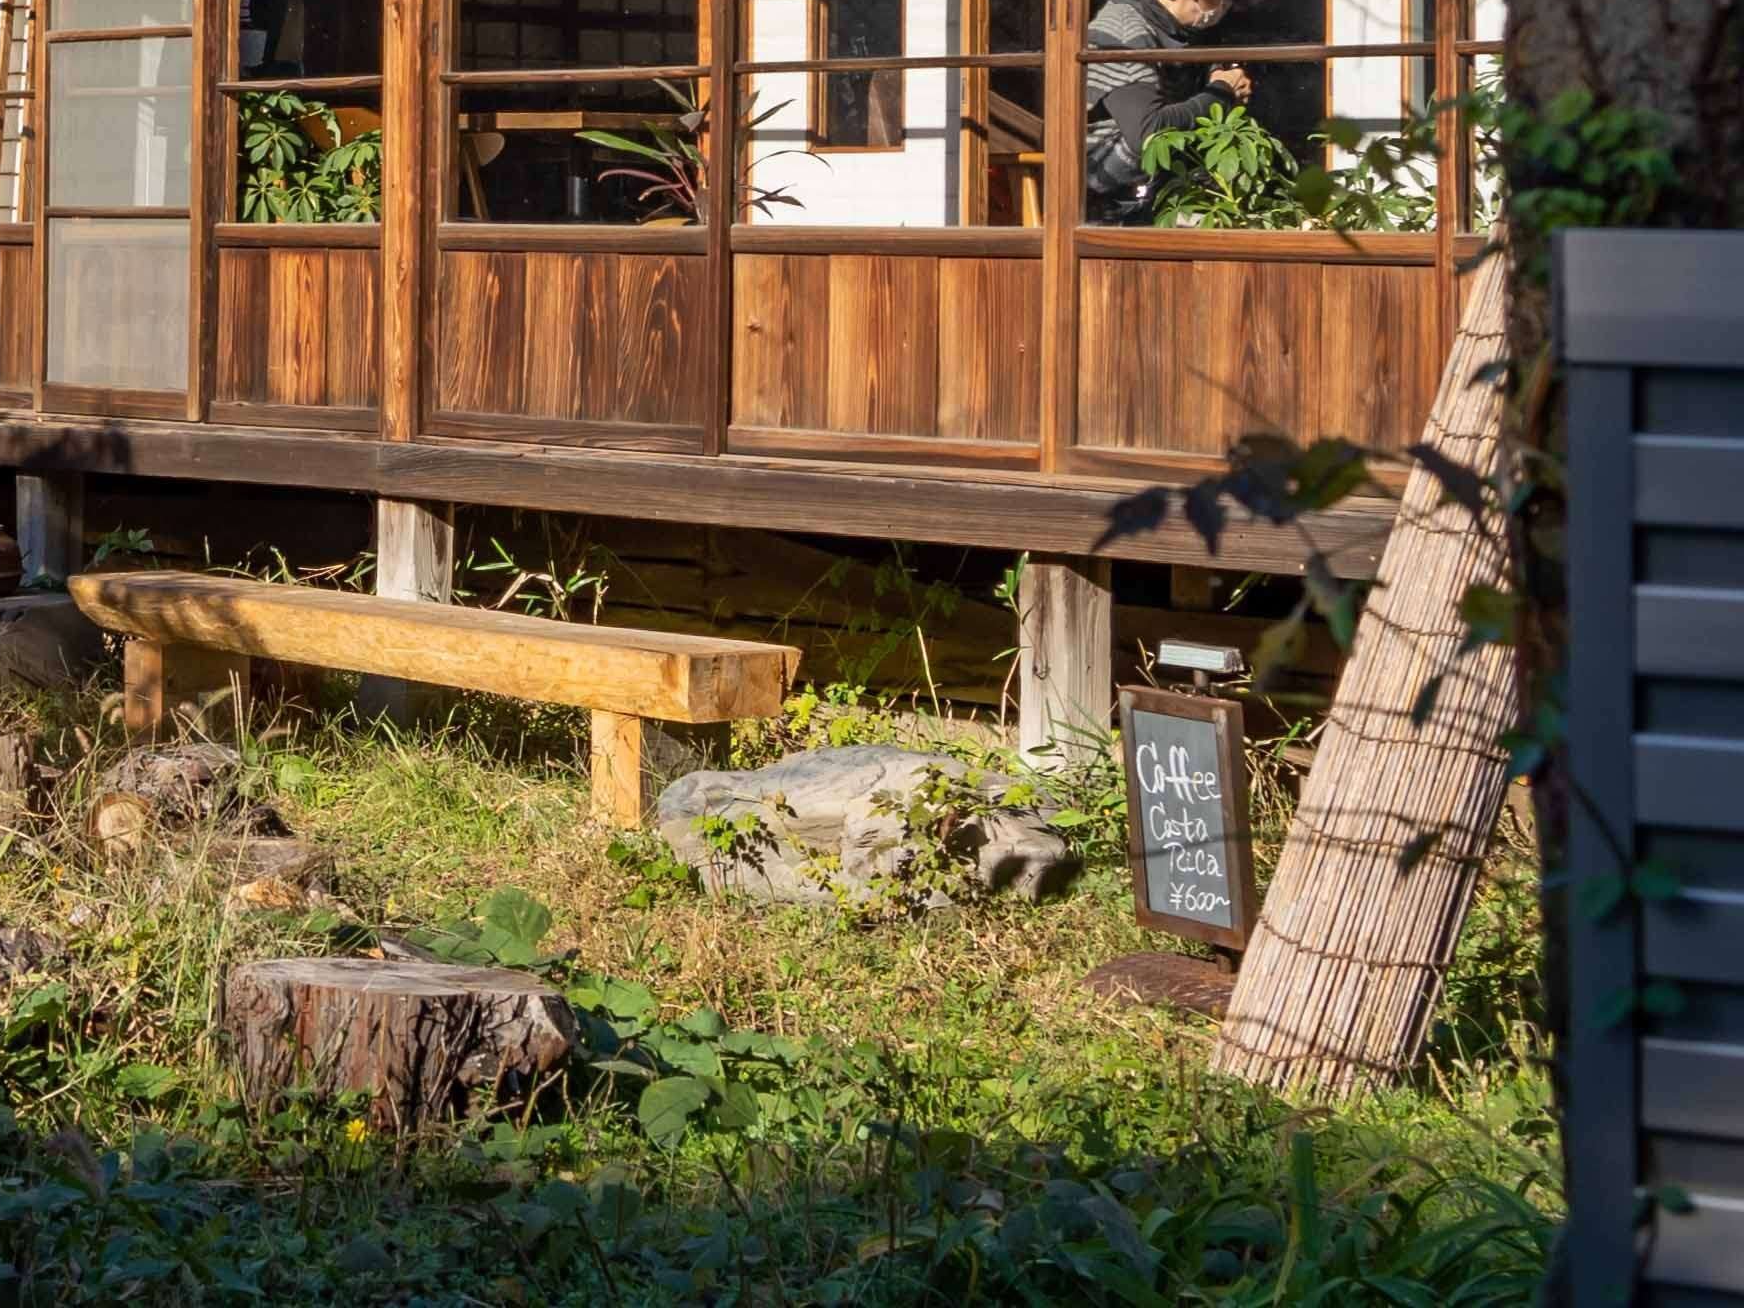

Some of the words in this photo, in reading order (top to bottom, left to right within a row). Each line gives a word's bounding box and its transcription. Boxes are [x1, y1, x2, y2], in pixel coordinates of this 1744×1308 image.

[1136, 742, 1222, 804] Coffee
[1149, 801, 1209, 842] Costa
[1162, 842, 1224, 877] Rica
